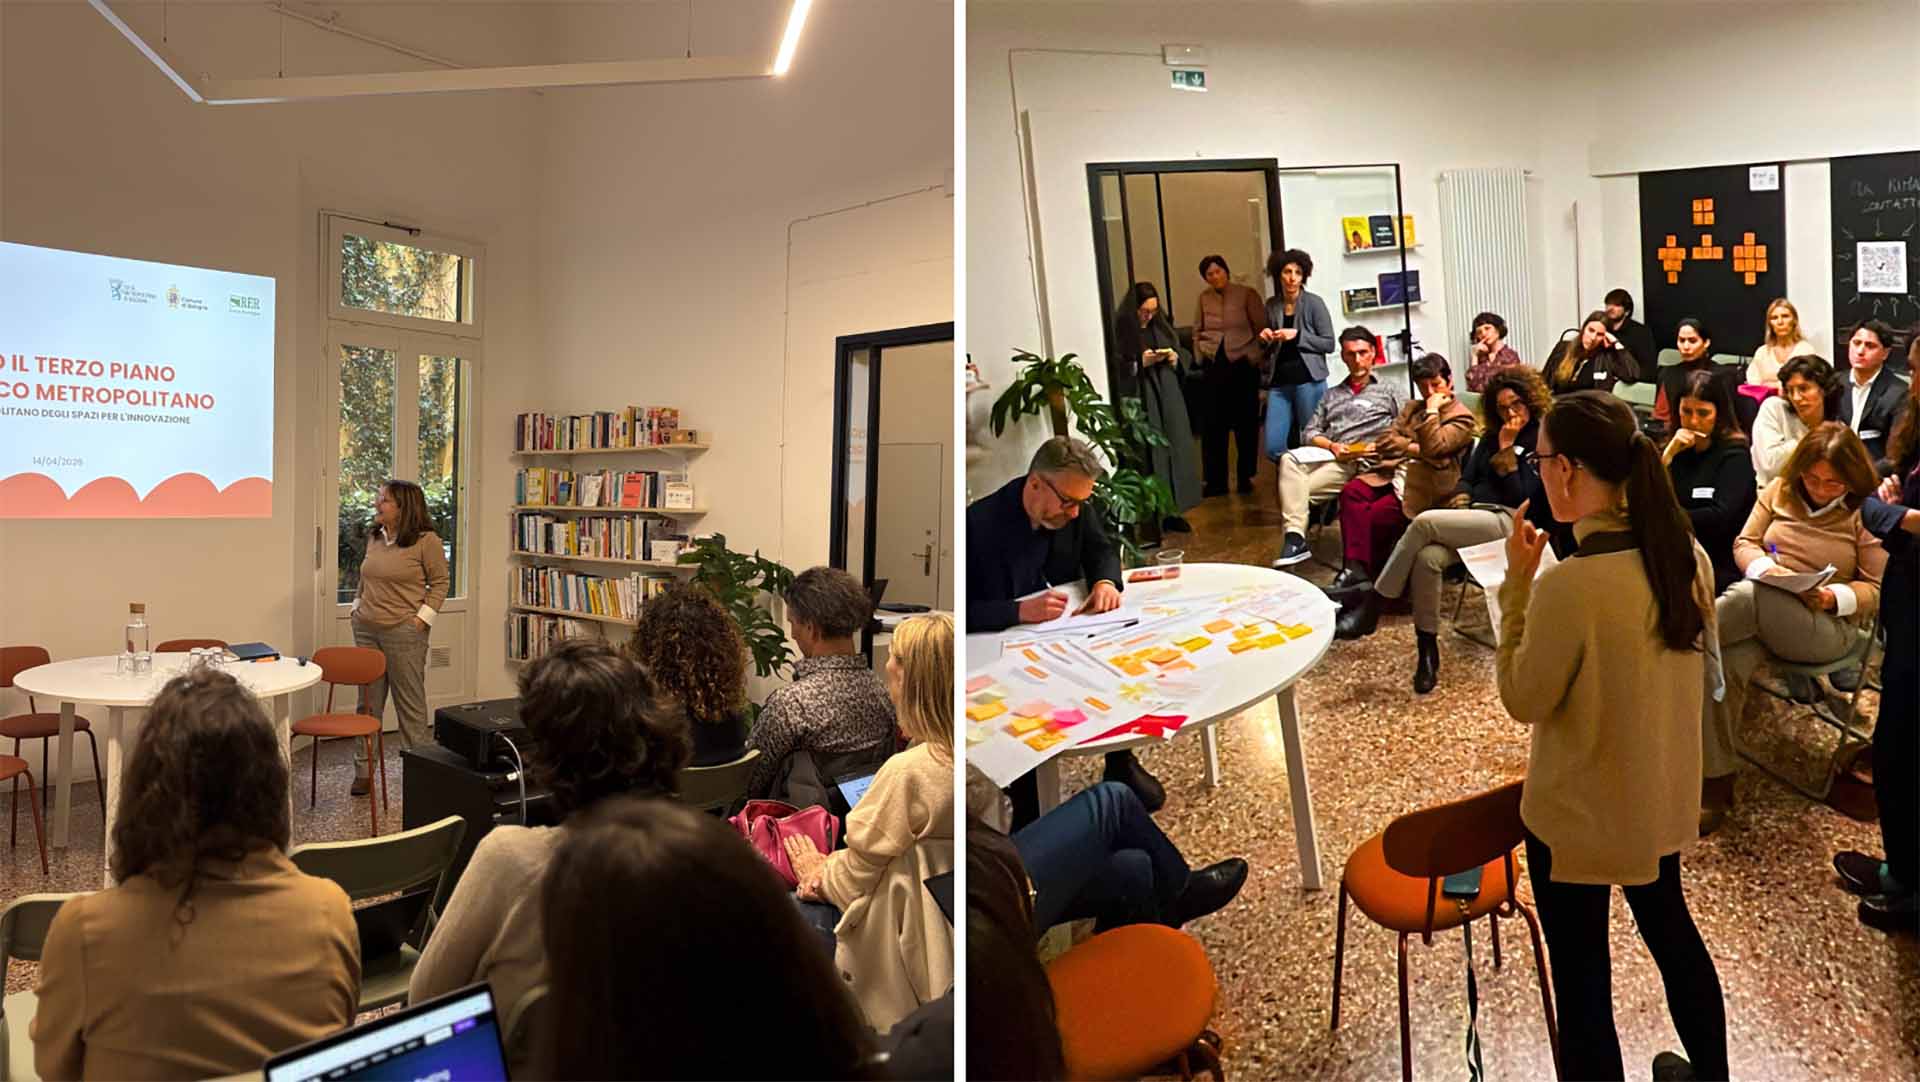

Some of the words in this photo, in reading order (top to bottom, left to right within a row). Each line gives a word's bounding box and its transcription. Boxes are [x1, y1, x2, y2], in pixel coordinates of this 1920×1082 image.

[11, 354, 29, 372] IL
[35, 356, 104, 377] TERZO
[110, 362, 175, 382] PIANO
[36, 383, 215, 410] METROPOLITANO
[0, 407, 40, 417] LITANO
[41, 409, 69, 418] DEGLI
[71, 411, 99, 420] SPAZI
[101, 412, 118, 421] PER
[120, 412, 191, 424] L'INNOVAZIONE
